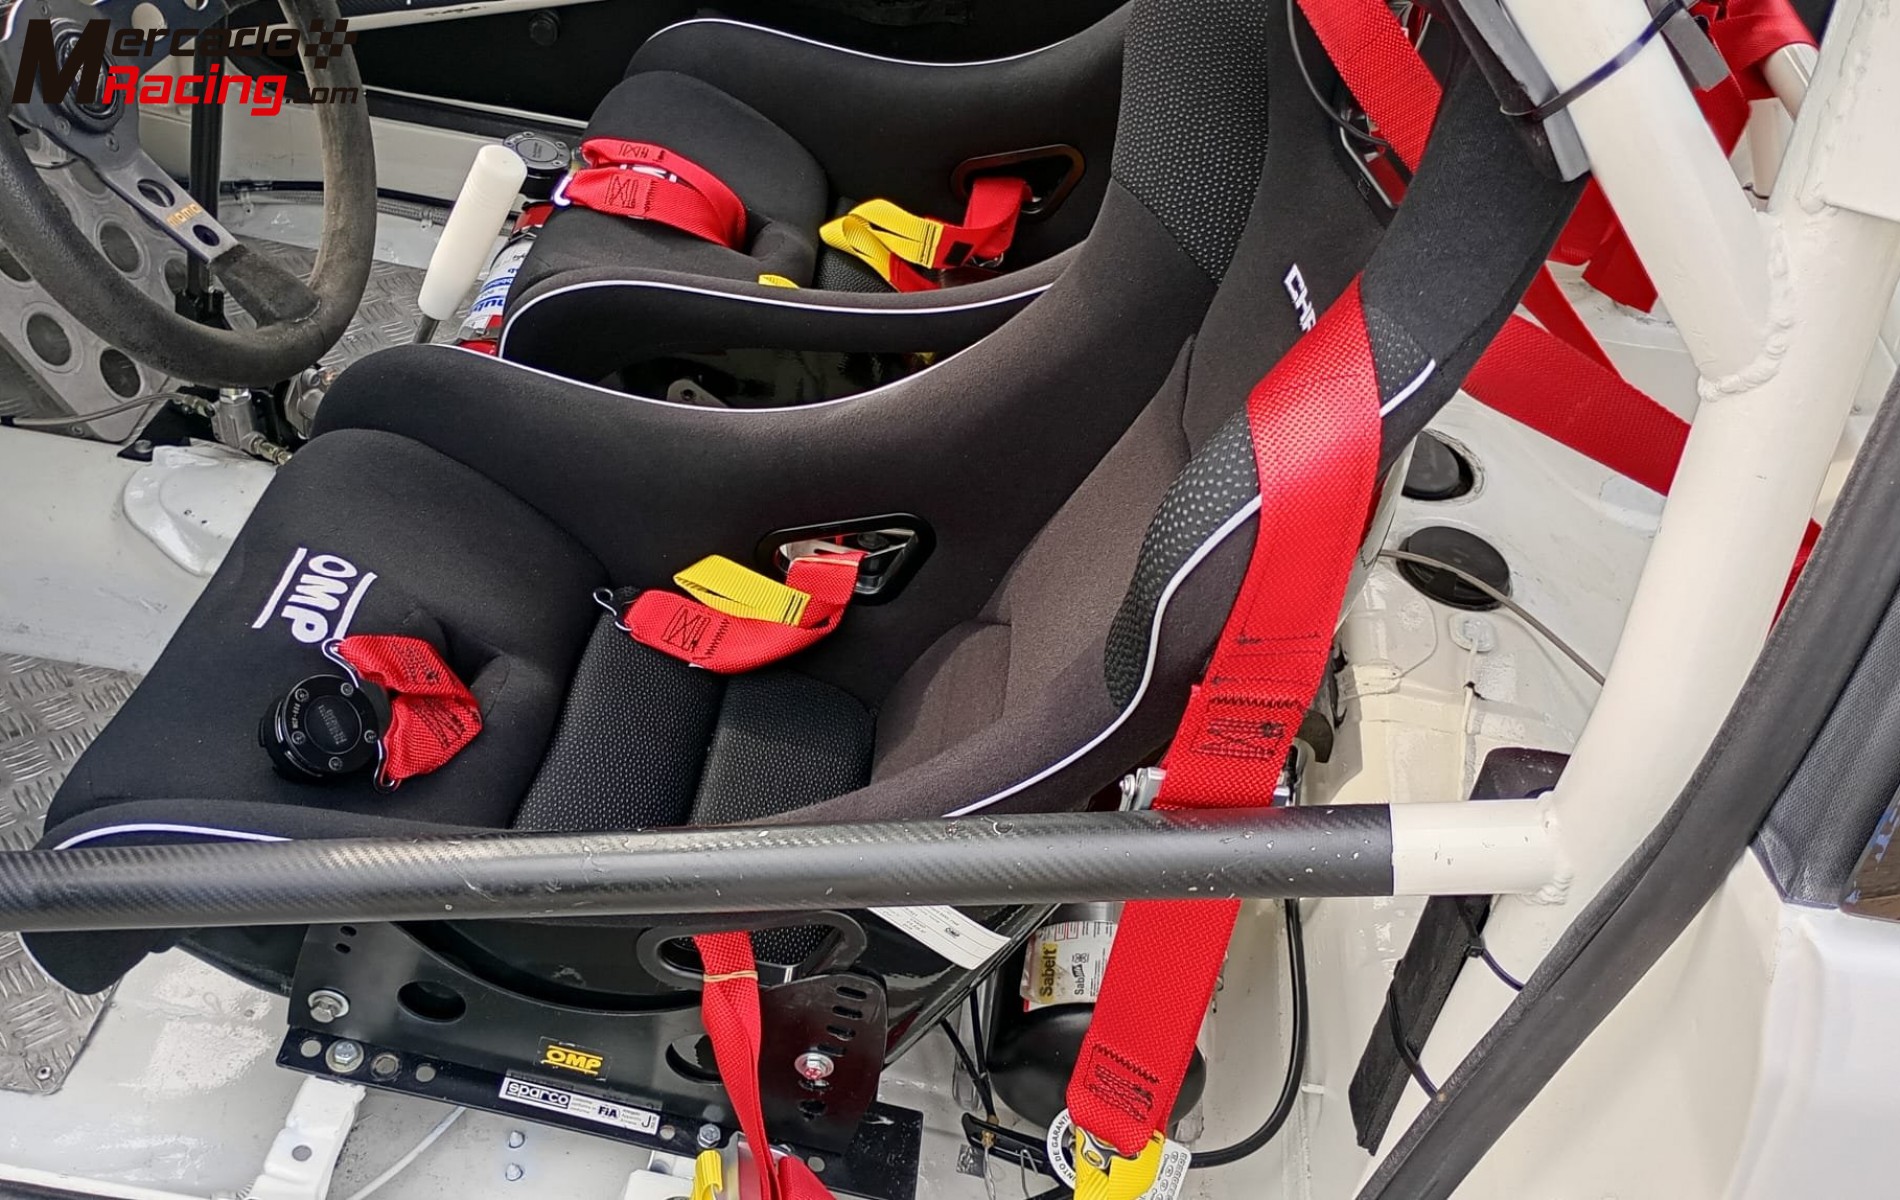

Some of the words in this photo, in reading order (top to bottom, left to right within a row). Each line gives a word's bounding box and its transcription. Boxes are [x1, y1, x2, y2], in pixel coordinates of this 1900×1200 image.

[281, 554, 358, 643] OMP
[1040, 947, 1057, 997] Sabelt
[546, 1049, 602, 1070] OMP
[507, 1081, 569, 1106] sparco
[1054, 1151, 1062, 1162] DE
